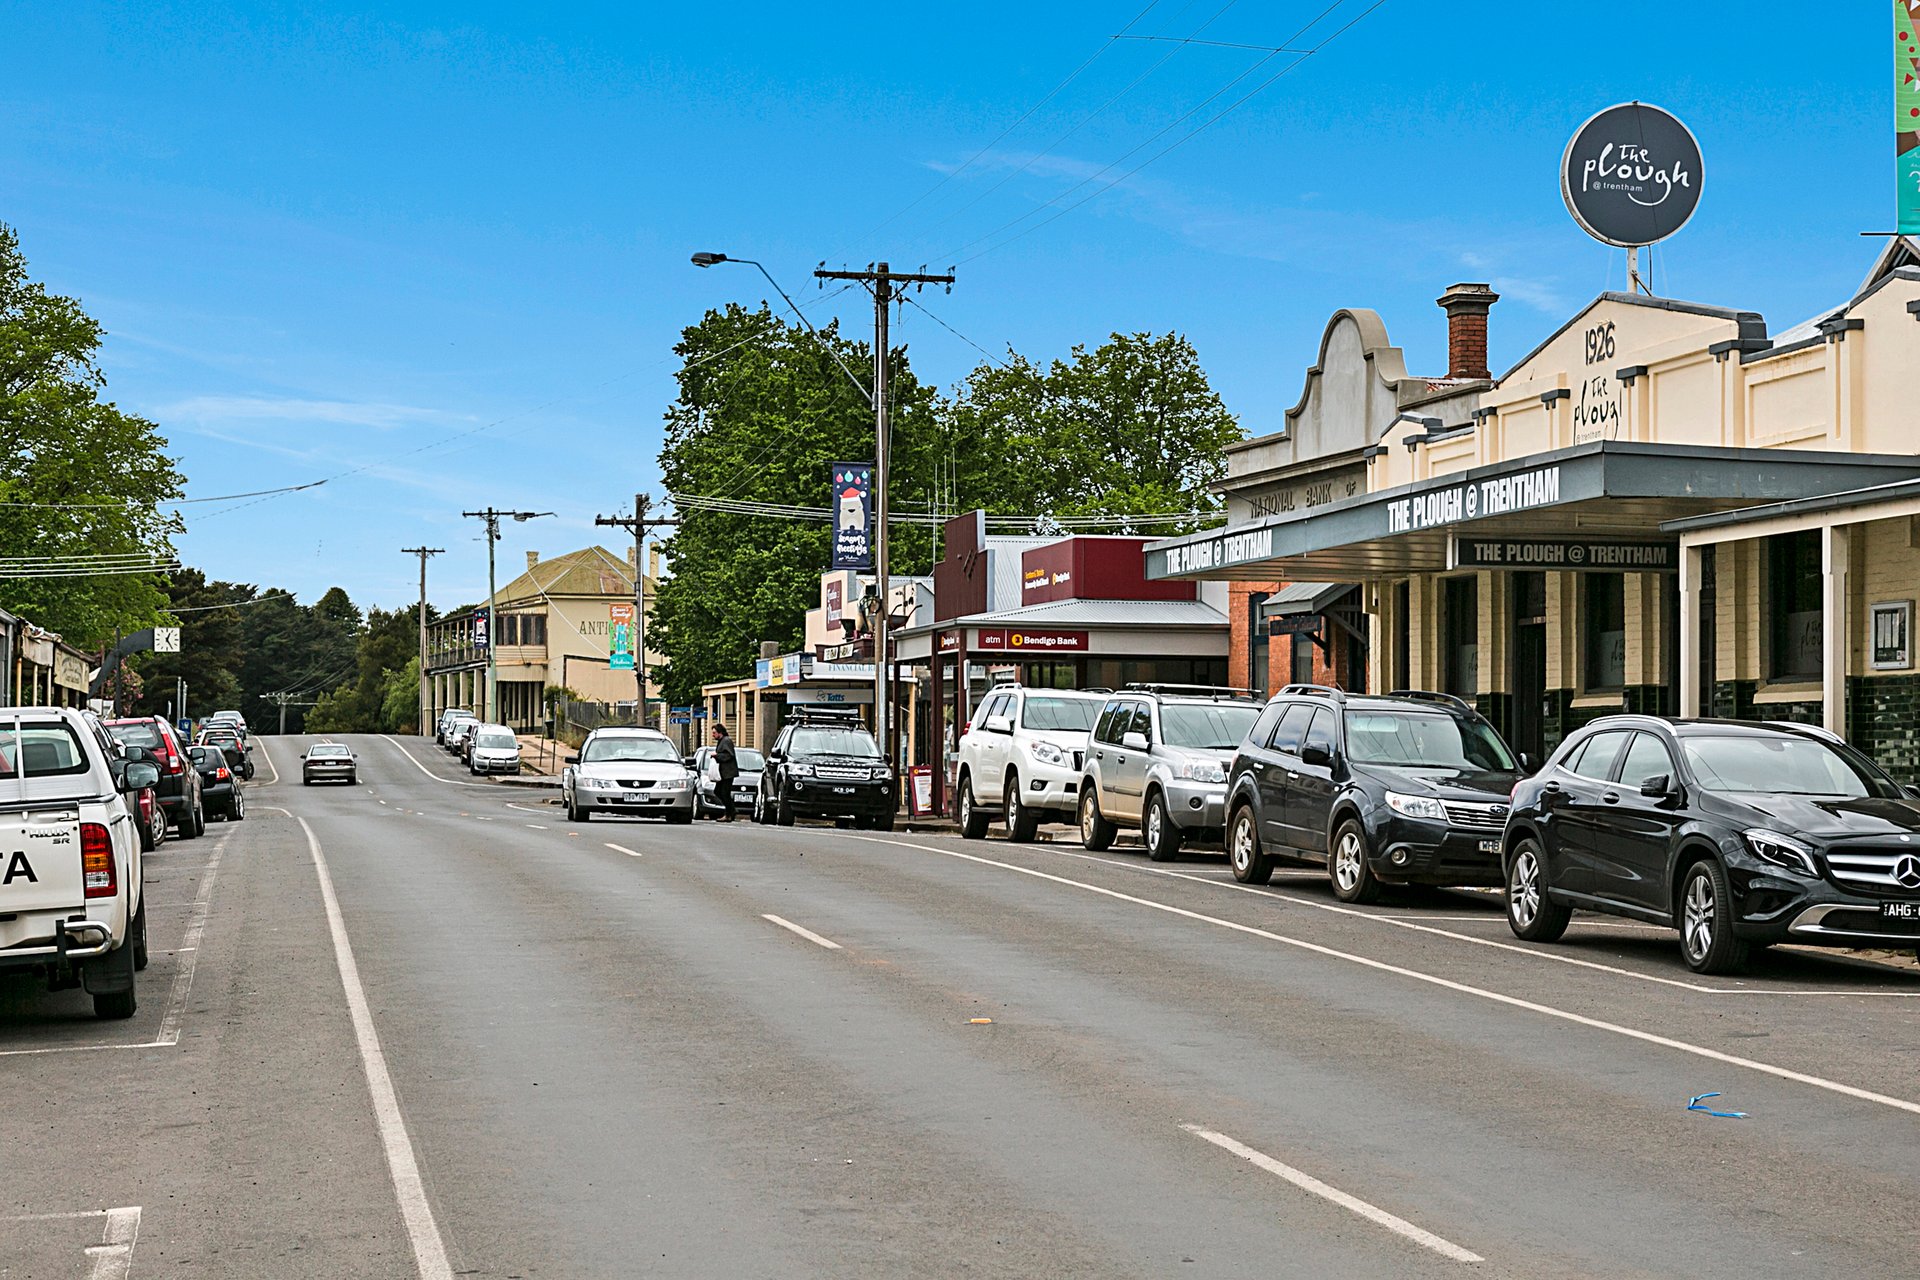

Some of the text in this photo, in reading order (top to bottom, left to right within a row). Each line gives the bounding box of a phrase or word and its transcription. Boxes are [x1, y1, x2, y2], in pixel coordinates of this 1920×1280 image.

[1619, 144, 1650, 163] The
[1583, 142, 1690, 206] plough
[1603, 182, 1643, 192] trentham
[1585, 320, 1615, 366] 1926
[1591, 376, 1608, 398] The
[1250, 481, 1356, 519] NATIONAL BANK OF
[1388, 466, 1560, 533] THE PLOUGH @ TRENTHAM
[1166, 529, 1273, 575] THE PLOUGH @ TRENTHAM
[1474, 543, 1667, 564] THE PLOUGH @ TRENTHAM
[985, 636, 1078, 646] atm Bendigo Bank
[828, 664, 865, 672] FINANCIAL
[827, 692, 845, 702] Tatts
[29, 827, 70, 838] HILUX
